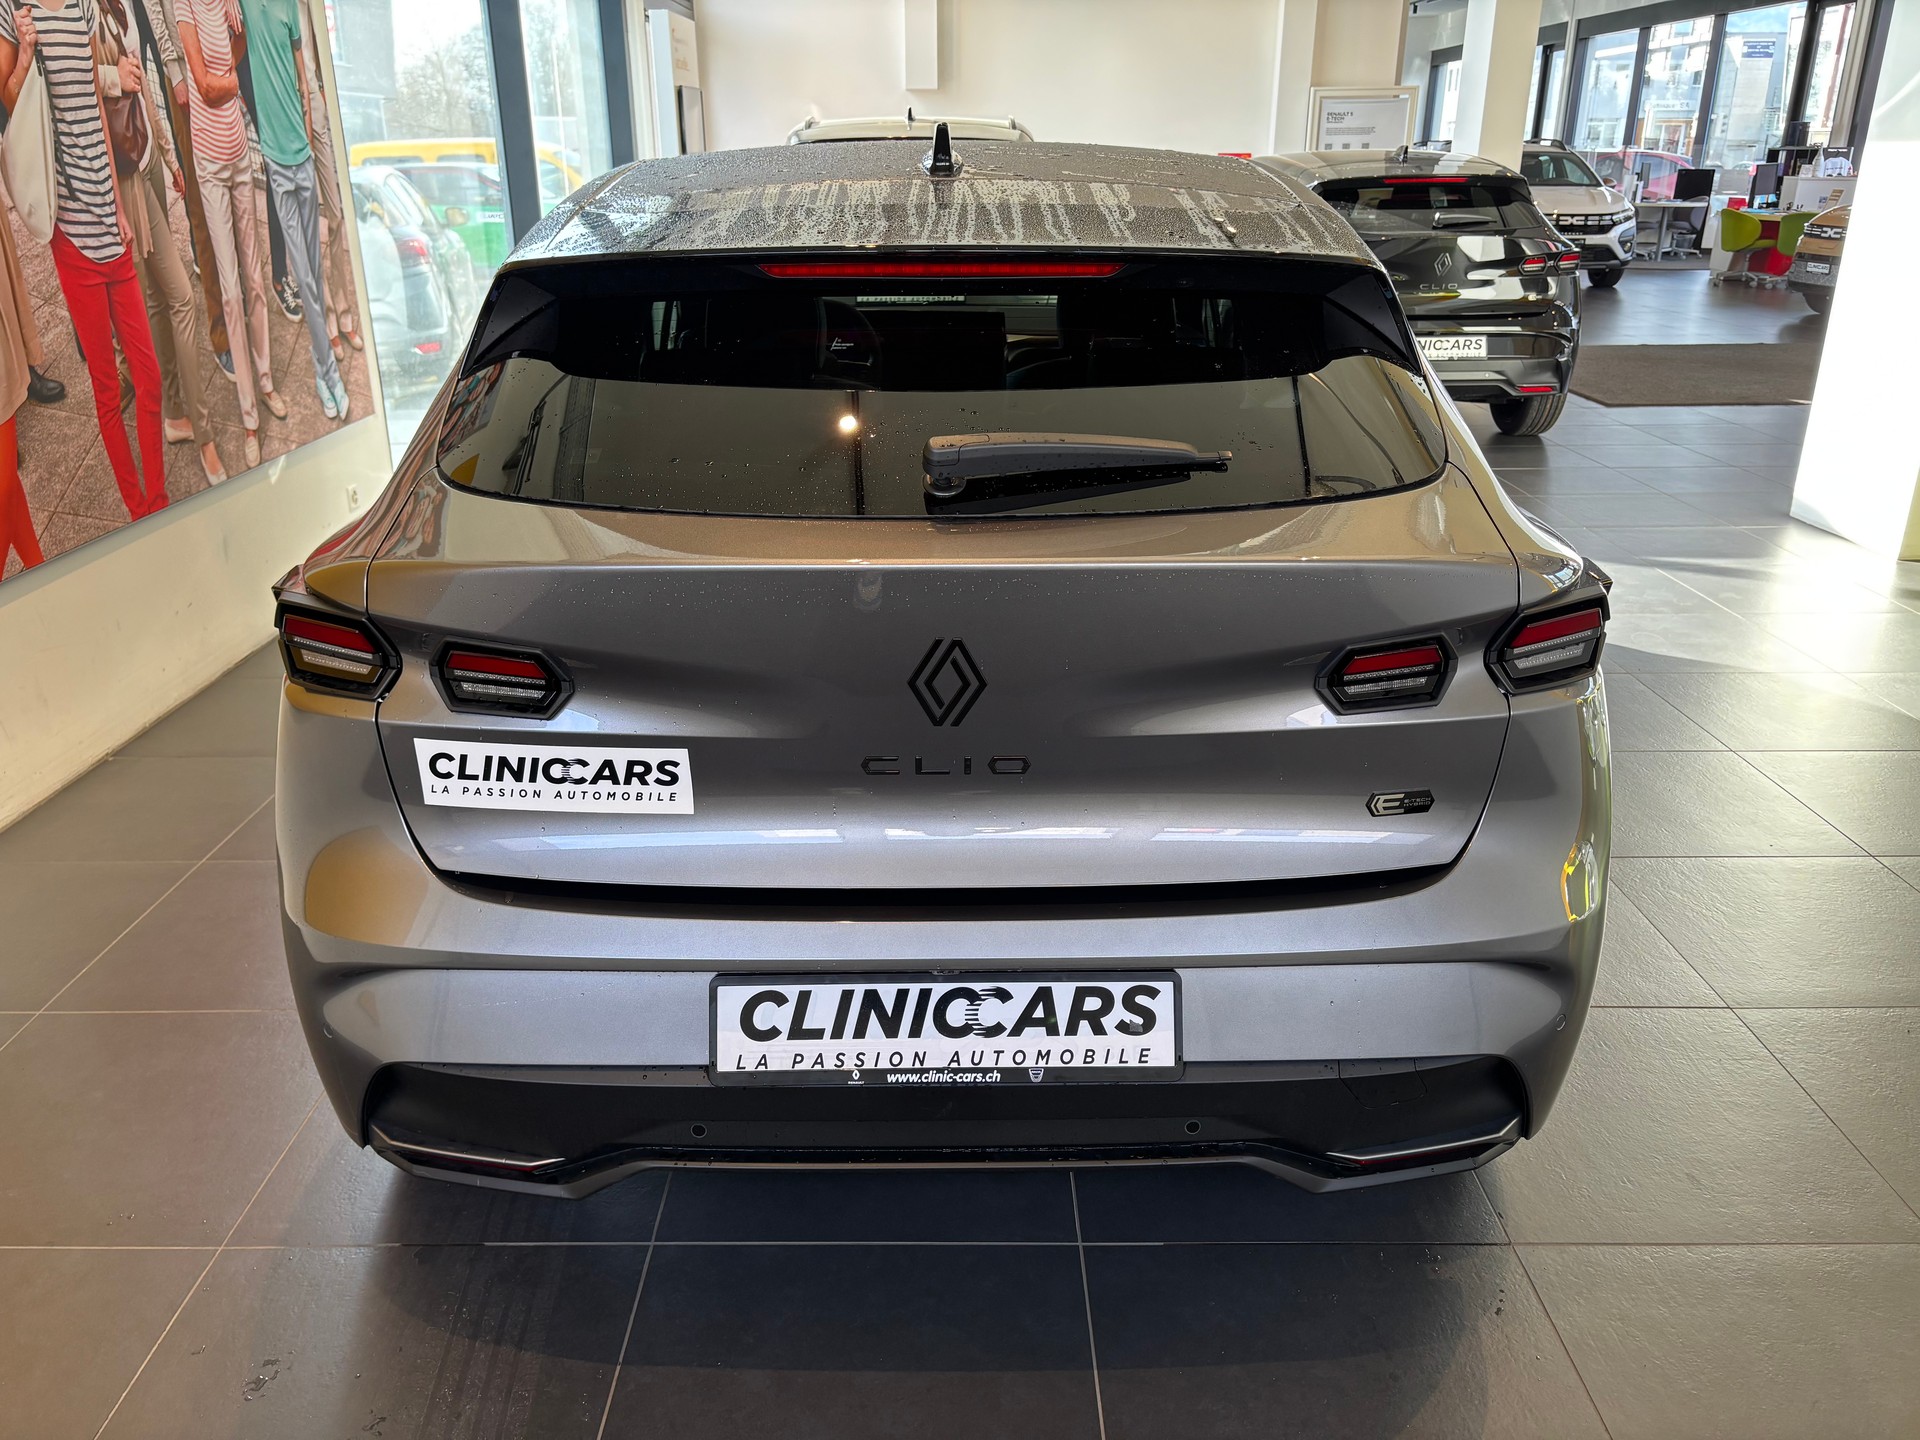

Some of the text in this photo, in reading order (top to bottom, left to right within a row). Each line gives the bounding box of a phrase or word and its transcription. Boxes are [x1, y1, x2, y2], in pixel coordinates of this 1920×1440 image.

[1418, 339, 1483, 351] NICCARS
[429, 752, 681, 787] CLINICCARS
[861, 755, 1031, 775] CLIO
[431, 784, 678, 802] LA PASSION AUTOMOBILE
[739, 985, 1162, 1042] CLINICCARS
[736, 1047, 1152, 1070] LA PASSION AUTOMOBILE
[886, 1069, 1001, 1083] www.clinic-cars.ch
